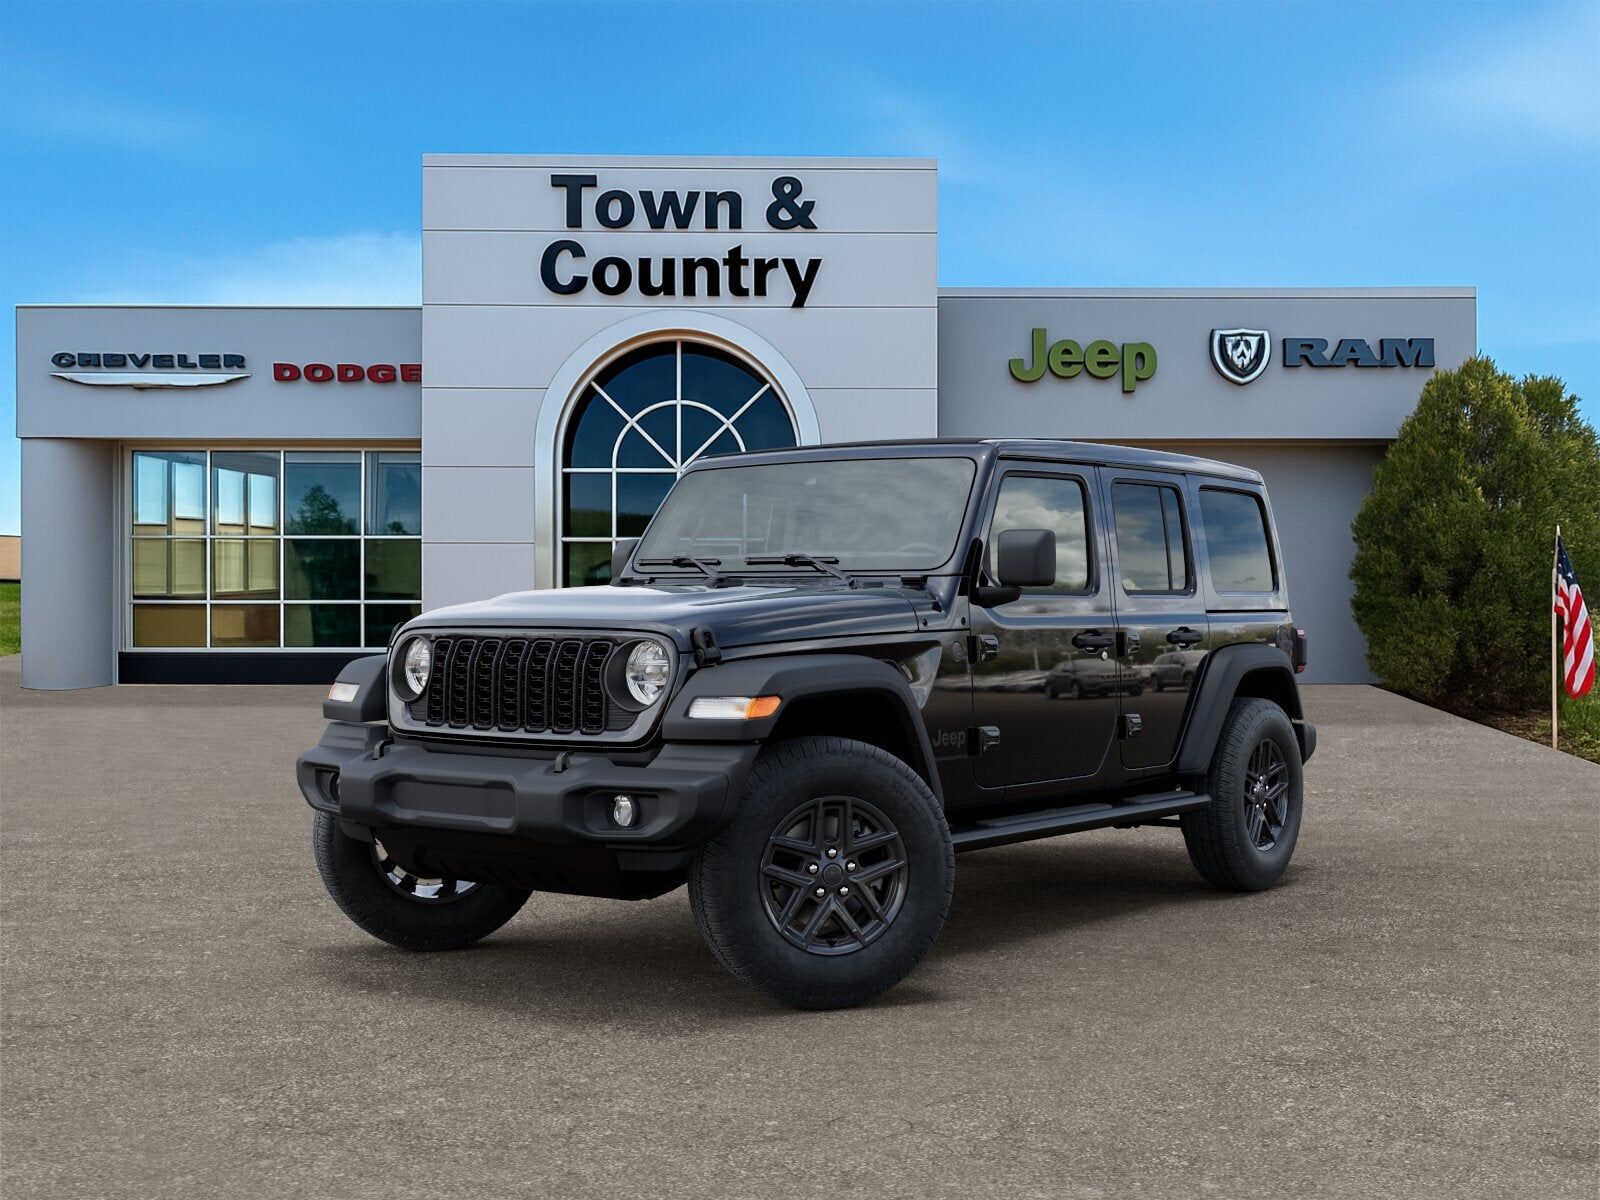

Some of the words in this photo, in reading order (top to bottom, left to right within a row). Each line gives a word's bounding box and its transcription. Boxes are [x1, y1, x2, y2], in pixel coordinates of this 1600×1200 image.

[550, 174, 743, 229] Town
[765, 175, 818, 230] &
[540, 239, 822, 308] Country
[272, 362, 422, 383] DODGE
[1009, 327, 1158, 393] Jeep
[1282, 337, 1436, 368] RAM
[932, 728, 966, 748] Jeep
